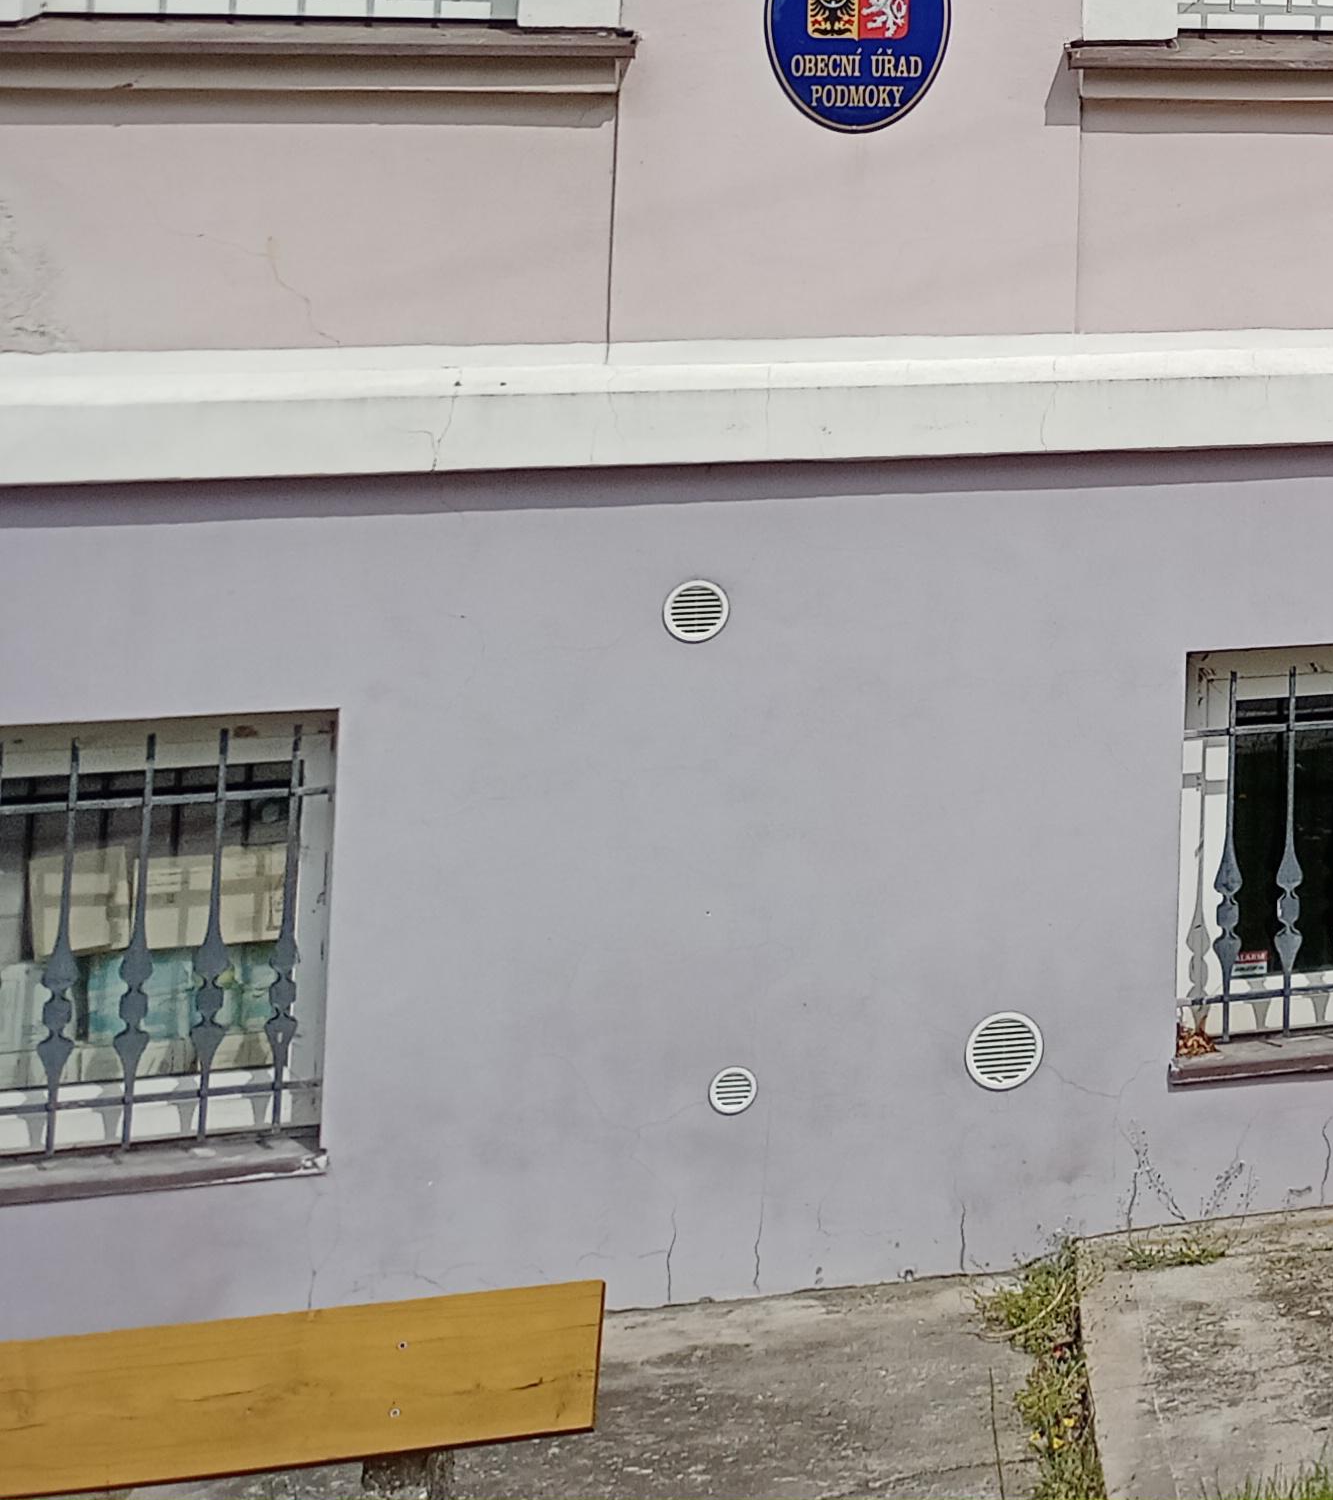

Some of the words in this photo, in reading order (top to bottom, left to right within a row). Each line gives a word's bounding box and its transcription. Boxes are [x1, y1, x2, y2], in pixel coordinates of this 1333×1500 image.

[791, 48, 862, 77] OBECNÍ
[871, 48, 923, 78] ÚŘAD
[810, 85, 905, 108] PODMOKY
